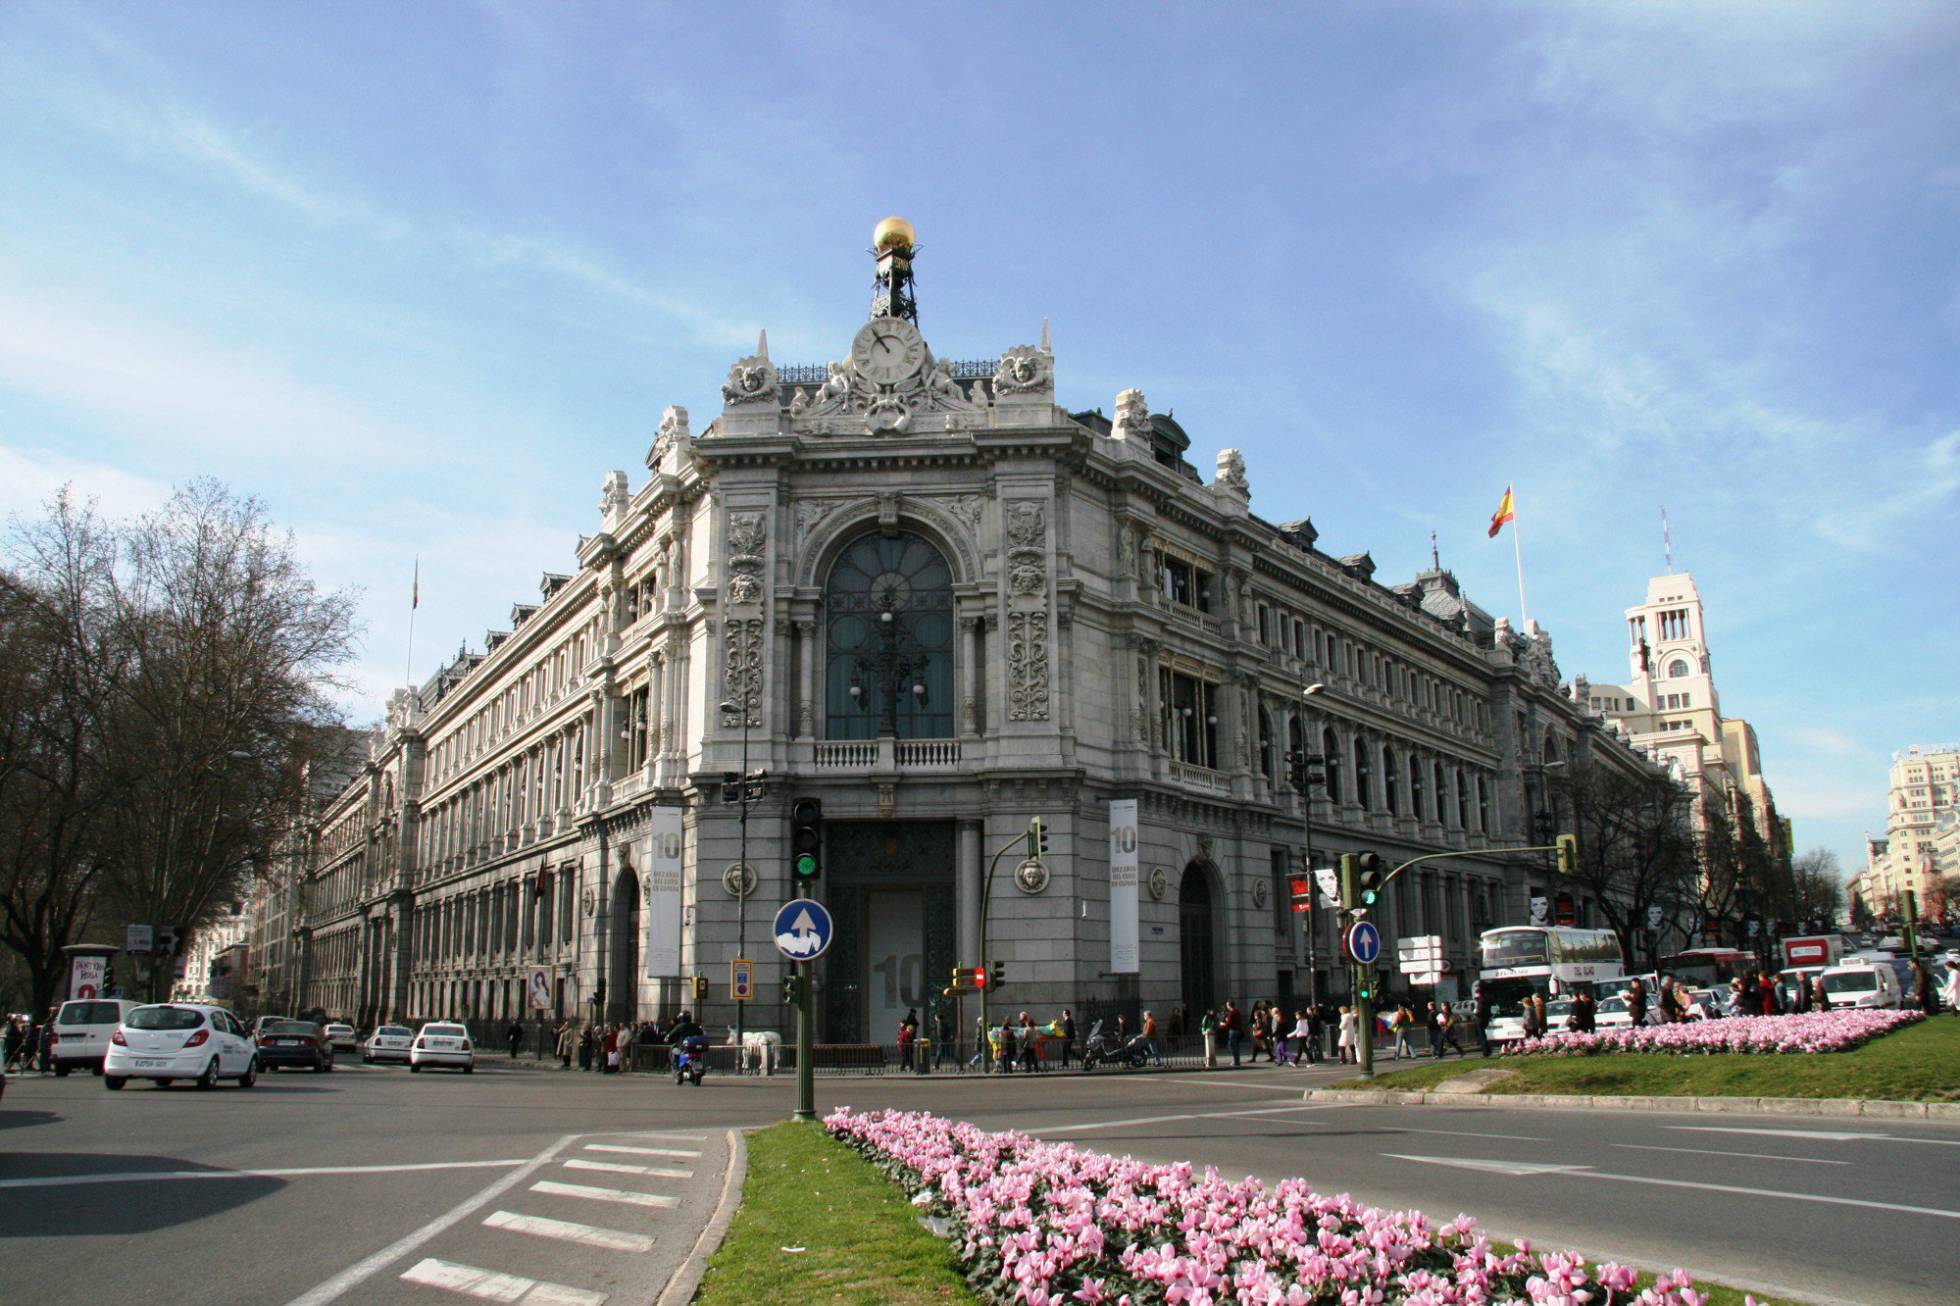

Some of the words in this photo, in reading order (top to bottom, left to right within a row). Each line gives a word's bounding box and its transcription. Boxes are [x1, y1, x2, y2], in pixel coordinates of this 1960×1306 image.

[654, 831, 680, 859] 10
[1111, 825, 1136, 853] 10
[872, 954, 924, 1008] 10
